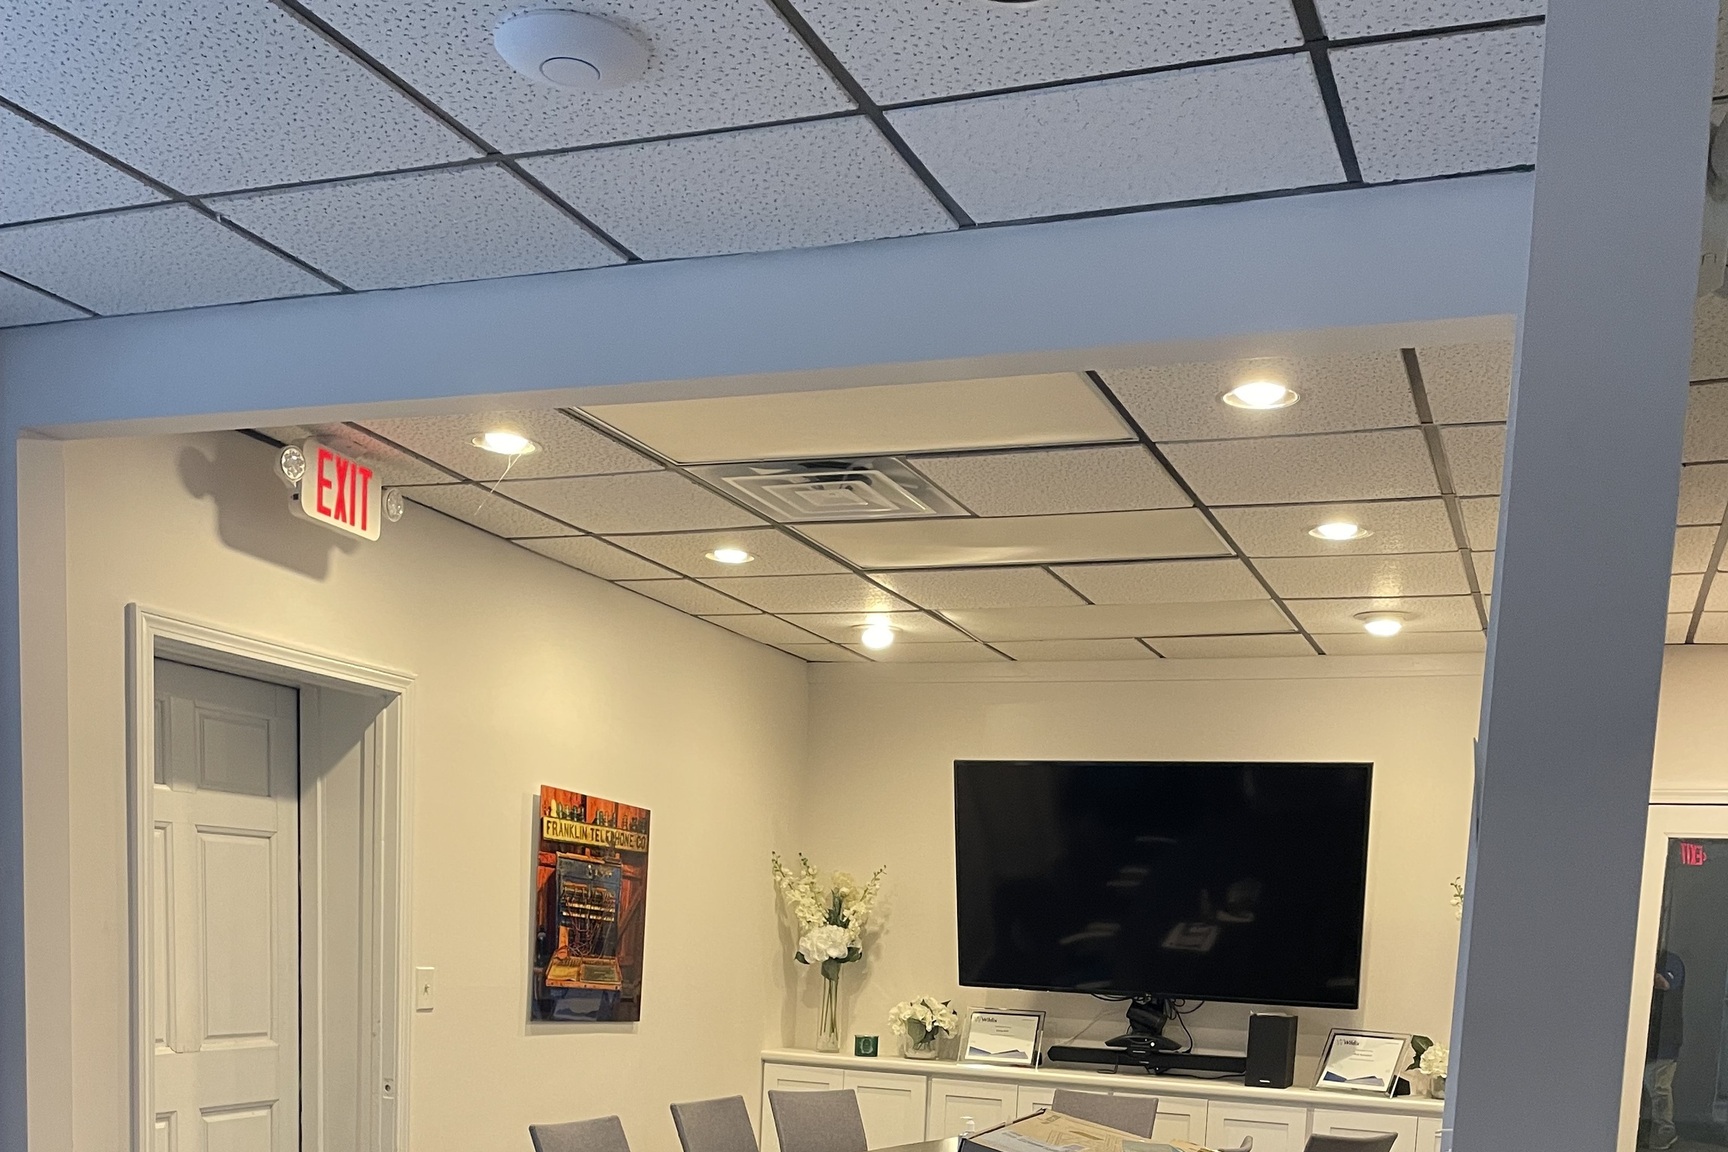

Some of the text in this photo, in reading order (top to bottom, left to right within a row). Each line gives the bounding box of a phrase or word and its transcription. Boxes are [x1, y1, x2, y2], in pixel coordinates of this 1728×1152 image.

[317, 448, 373, 531] EXIT
[546, 820, 588, 840] FRANKLIN
[590, 827, 635, 848] TELEPHONE
